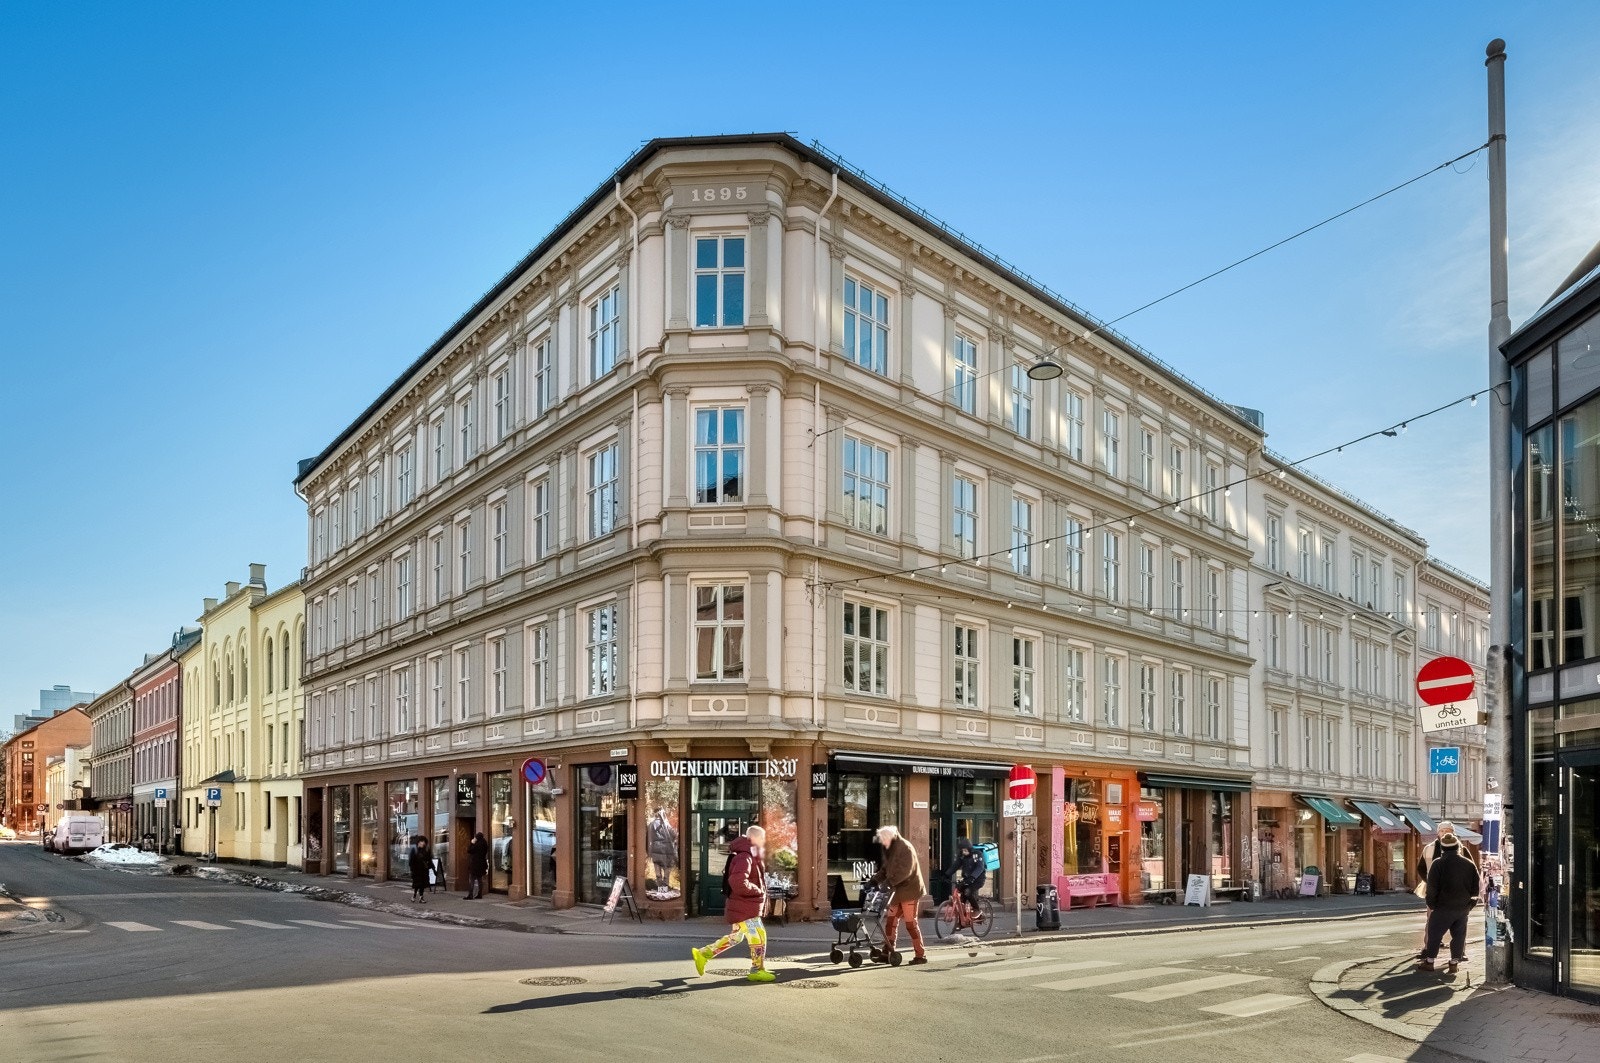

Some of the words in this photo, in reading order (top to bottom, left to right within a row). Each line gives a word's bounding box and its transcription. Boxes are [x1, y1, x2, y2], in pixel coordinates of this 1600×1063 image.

[691, 186, 747, 201] 1895
[1435, 718, 1467, 729] unntatt
[650, 760, 748, 777] OLIVENLUNDEN
[157, 789, 164, 798] P
[210, 789, 218, 799] P
